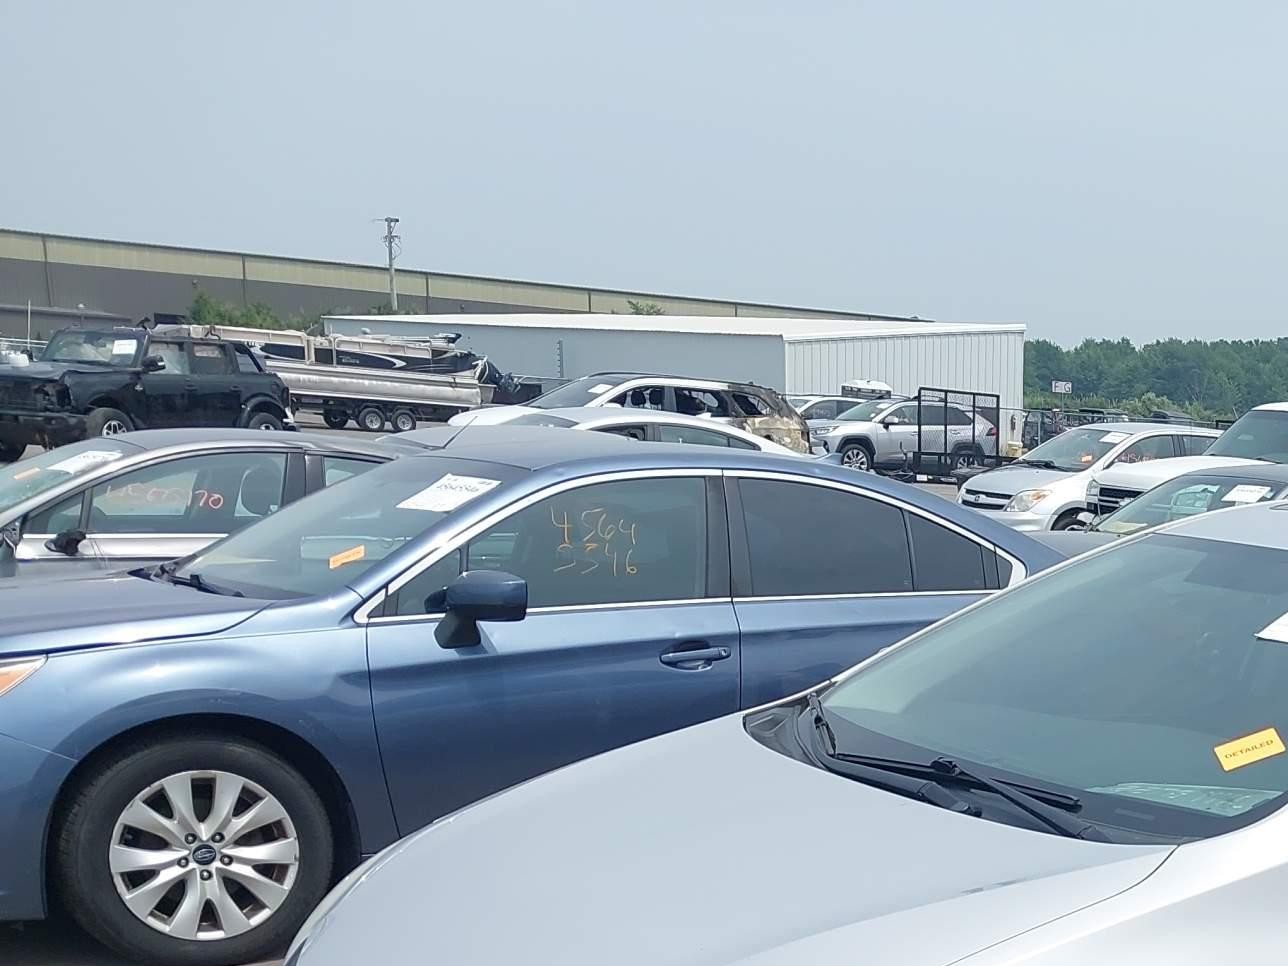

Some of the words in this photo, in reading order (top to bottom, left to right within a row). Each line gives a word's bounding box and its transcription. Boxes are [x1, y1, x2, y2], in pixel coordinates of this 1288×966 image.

[1063, 382, 1072, 393] G
[550, 505, 637, 545] 4564
[1224, 739, 1274, 759] DETAILED
